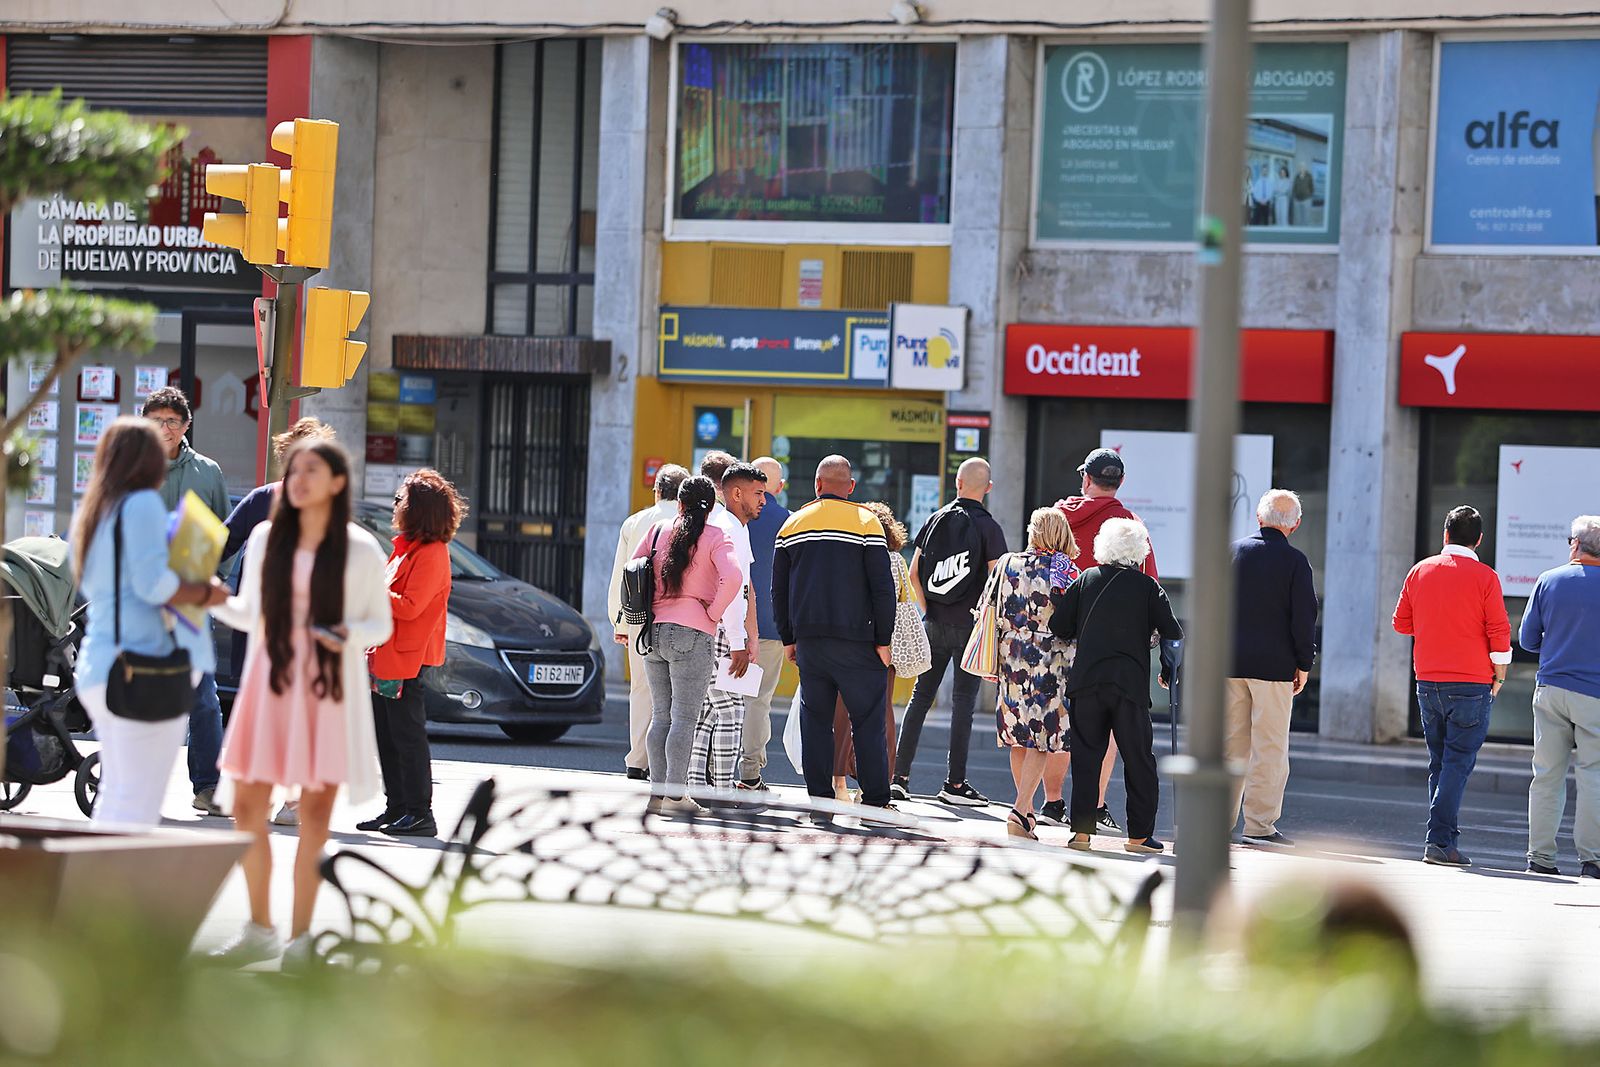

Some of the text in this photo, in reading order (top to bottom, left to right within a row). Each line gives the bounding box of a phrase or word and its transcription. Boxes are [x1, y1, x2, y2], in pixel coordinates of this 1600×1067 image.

[1117, 66, 1162, 87] LÓPEZ
[1254, 70, 1336, 88] ABOGADOS
[1464, 110, 1560, 150] alfa
[1063, 139, 1175, 151] ABOGADO EN HUELVA?
[1466, 154, 1561, 166] Centro de estudios
[38, 193, 136, 221] CÁMARA DE
[1469, 205, 1552, 219] centroalfa.es
[38, 224, 226, 249] LA PROPIEDAD URBA
[39, 249, 61, 271] DE
[64, 250, 129, 272] HUELVA
[132, 250, 144, 272] Y
[617, 352, 629, 384] 2
[1025, 343, 1141, 377] Occident
[933, 550, 970, 583] NIKE
[536, 666, 583, 683] 6162 HNF
